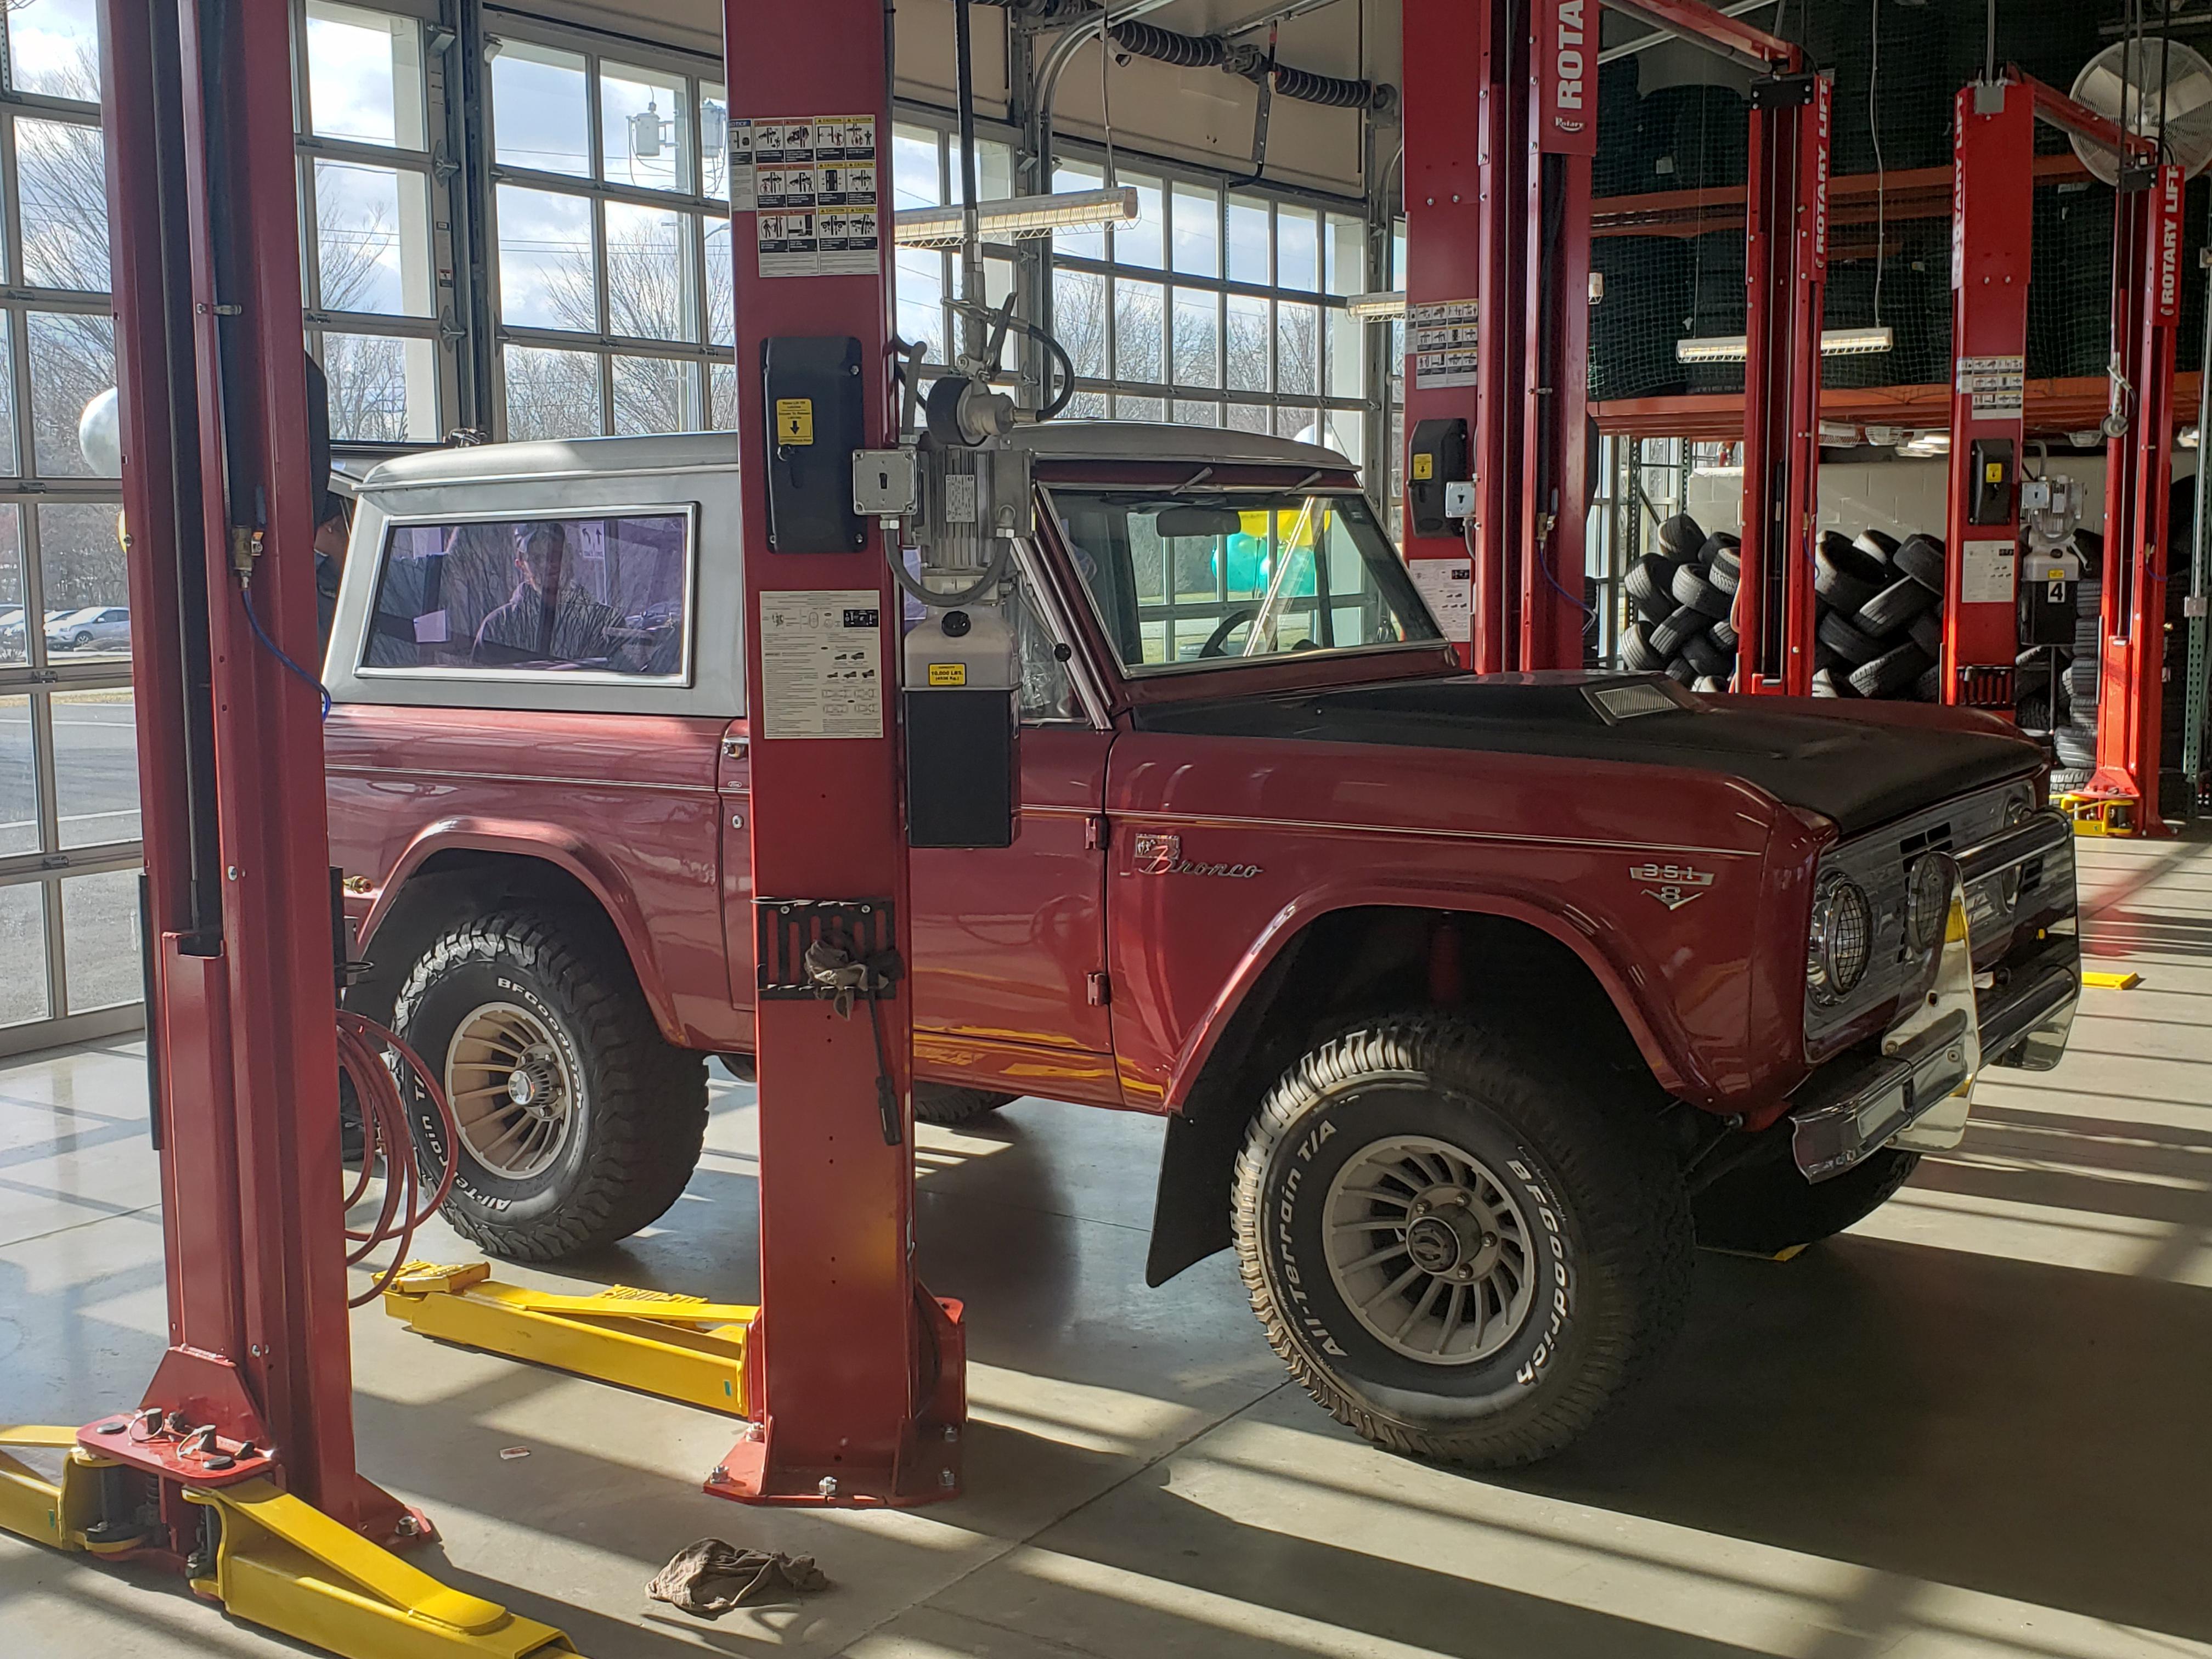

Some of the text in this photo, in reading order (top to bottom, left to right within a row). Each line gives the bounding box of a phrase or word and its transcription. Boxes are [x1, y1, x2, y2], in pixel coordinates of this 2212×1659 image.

[1818, 79, 1829, 138] LIFT
[1816, 144, 1826, 254] ROTARY
[2165, 166, 2179, 212] LIFT
[2161, 218, 2177, 304] ROTARY
[2050, 583, 2063, 601] 4
[1138, 845, 1263, 878] Bronco
[1644, 864, 1693, 879] 351
[498, 978, 583, 1109] BFGoodrich
[1280, 1120, 1348, 1356] All-Terrain T/A
[1505, 1160, 1567, 1384] BFGoodrich
